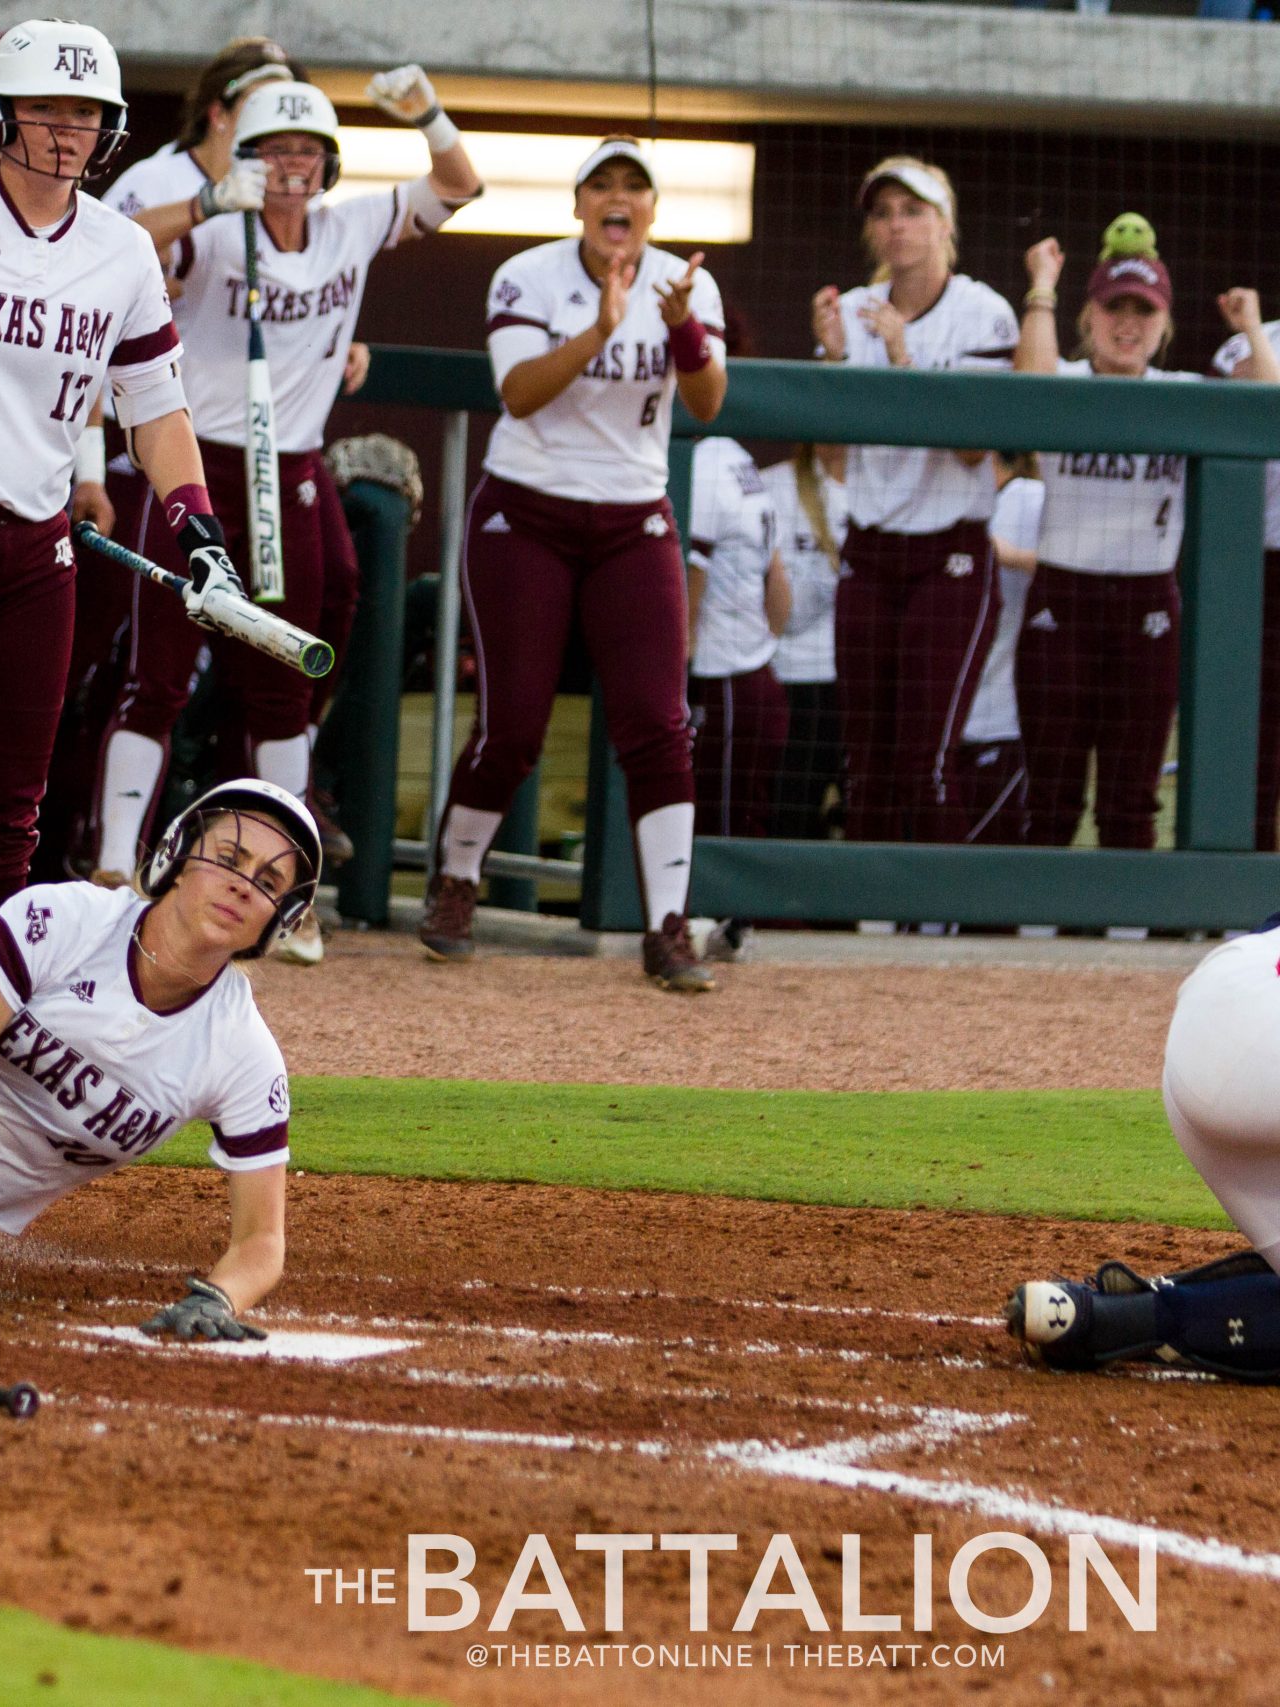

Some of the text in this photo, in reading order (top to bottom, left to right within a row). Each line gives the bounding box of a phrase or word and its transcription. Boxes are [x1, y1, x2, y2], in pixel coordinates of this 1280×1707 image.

[226, 277, 314, 323] TXAS
[54, 302, 114, 362] A&M
[49, 371, 93, 423] 17
[640, 392, 661, 426] 6
[253, 402, 278, 592] RAWLINGS
[1154, 495, 1172, 539] 4
[82, 1086, 177, 1156] A&M
